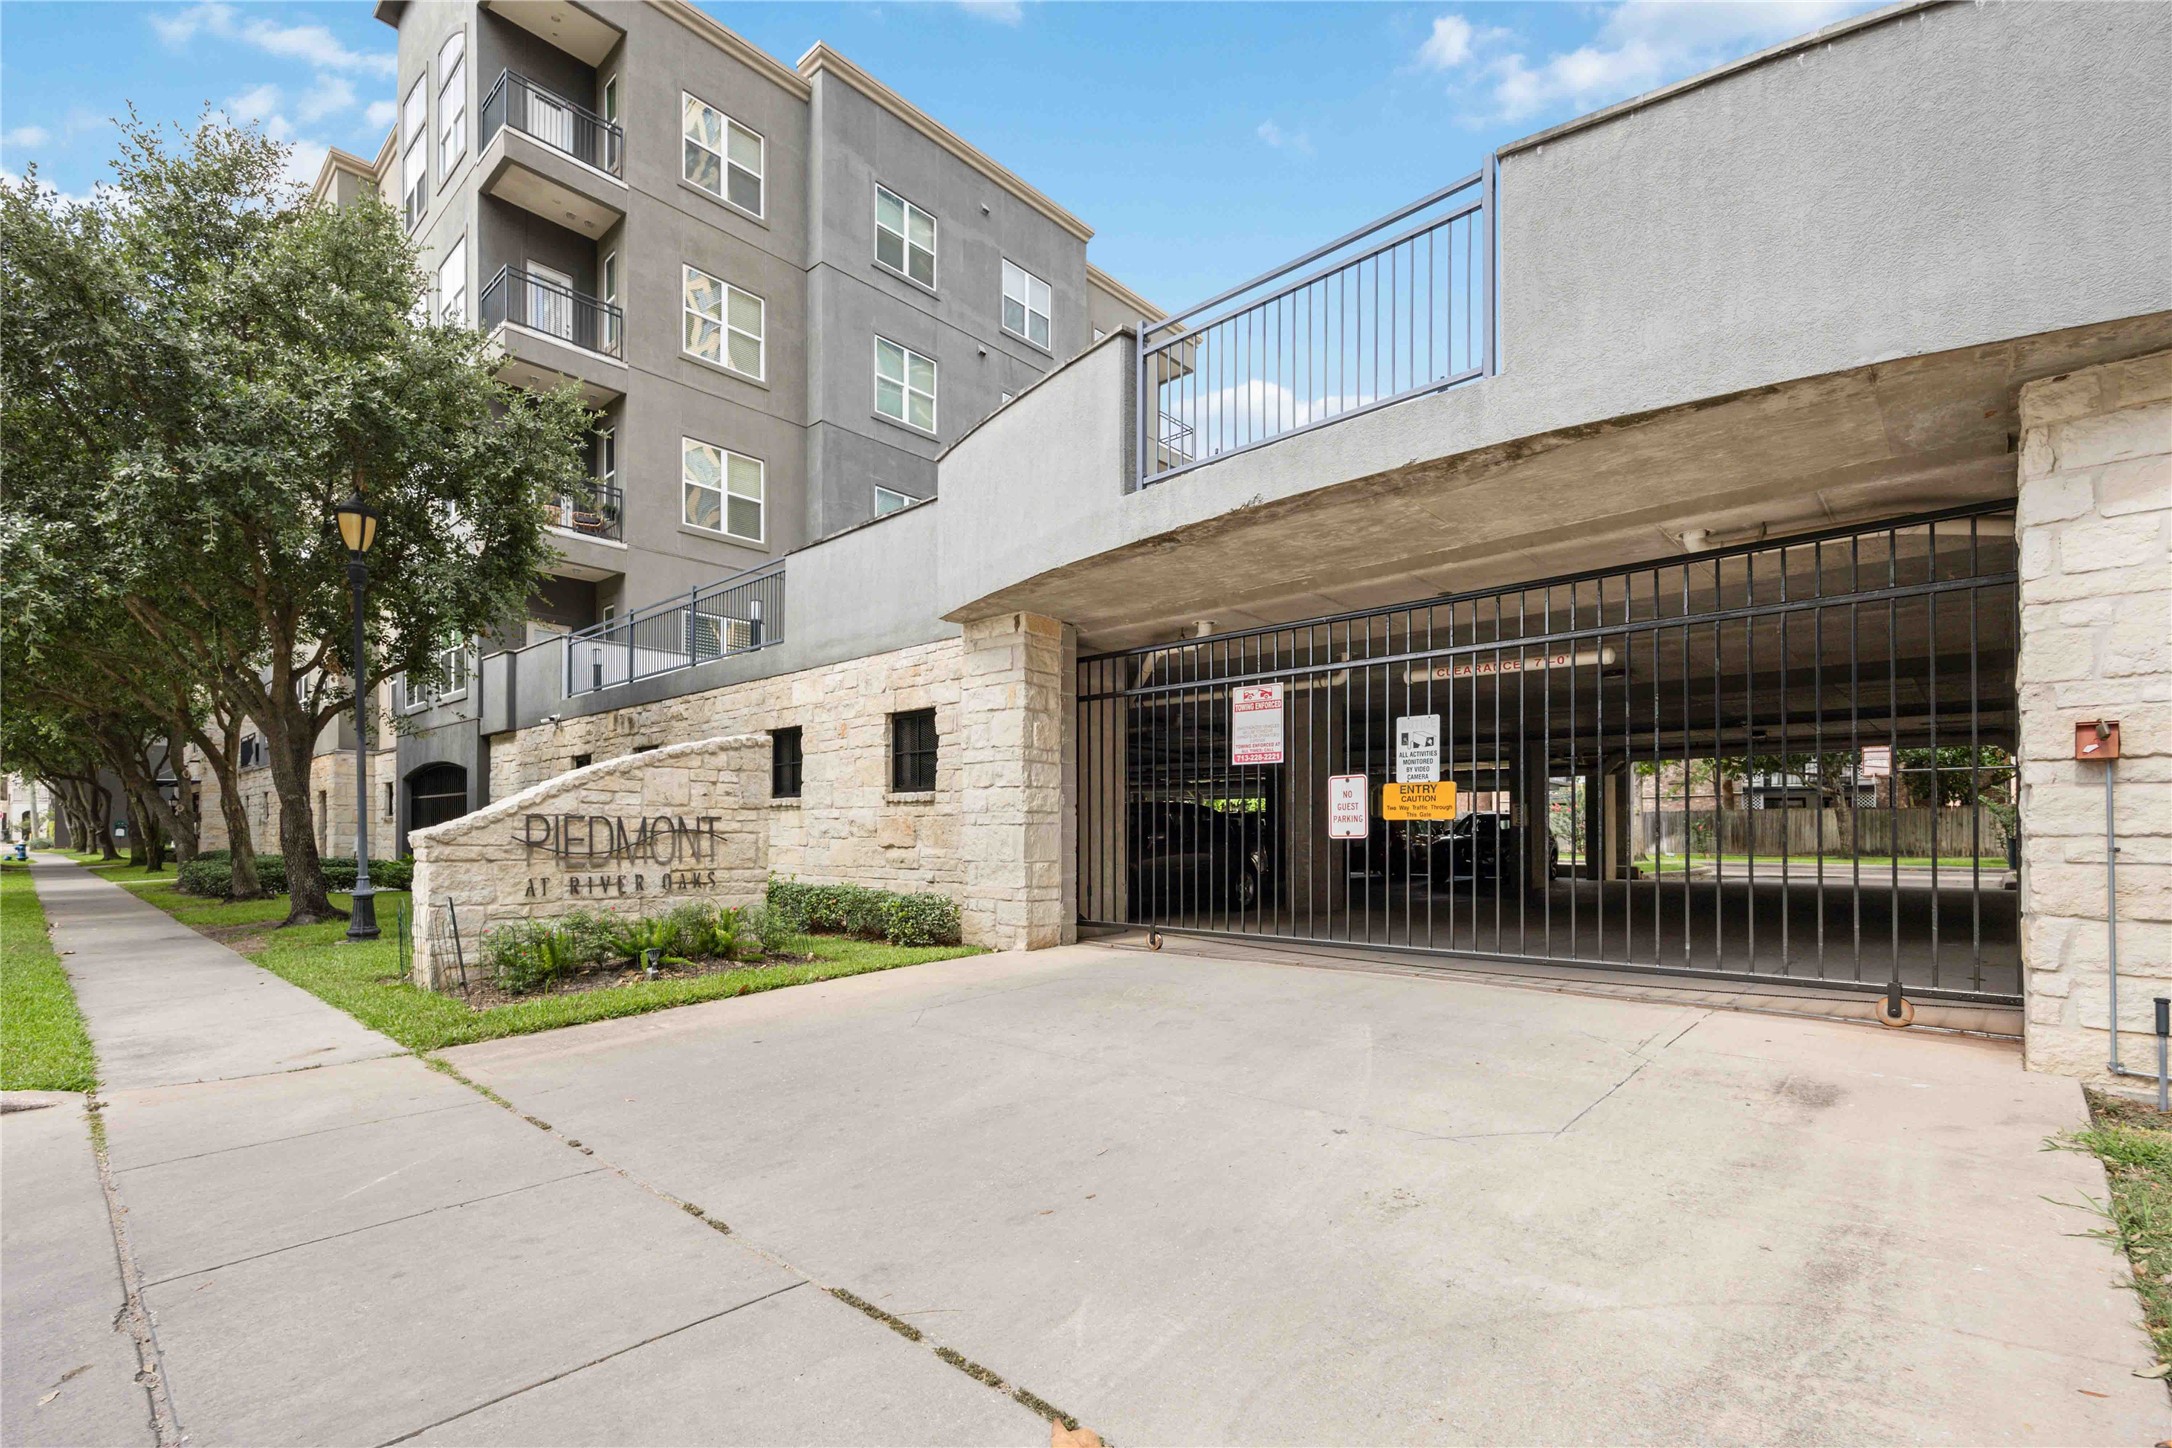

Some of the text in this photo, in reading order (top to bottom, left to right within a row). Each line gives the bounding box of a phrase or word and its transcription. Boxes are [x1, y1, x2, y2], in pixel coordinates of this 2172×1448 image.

[1235, 700, 1281, 711] TOWING ENFORCED
[1402, 758, 1434, 766] MONITORED
[1400, 784, 1437, 794] ENTRY
[1343, 790, 1353, 799] NO
[1401, 794, 1436, 803] CAUTION
[1337, 802, 1359, 811] GUEST
[1431, 803, 1453, 811] Through
[1333, 814, 1363, 824] PARKING
[524, 813, 723, 868] PIEDMONT
[525, 871, 716, 897] AT RIVER OAKS
